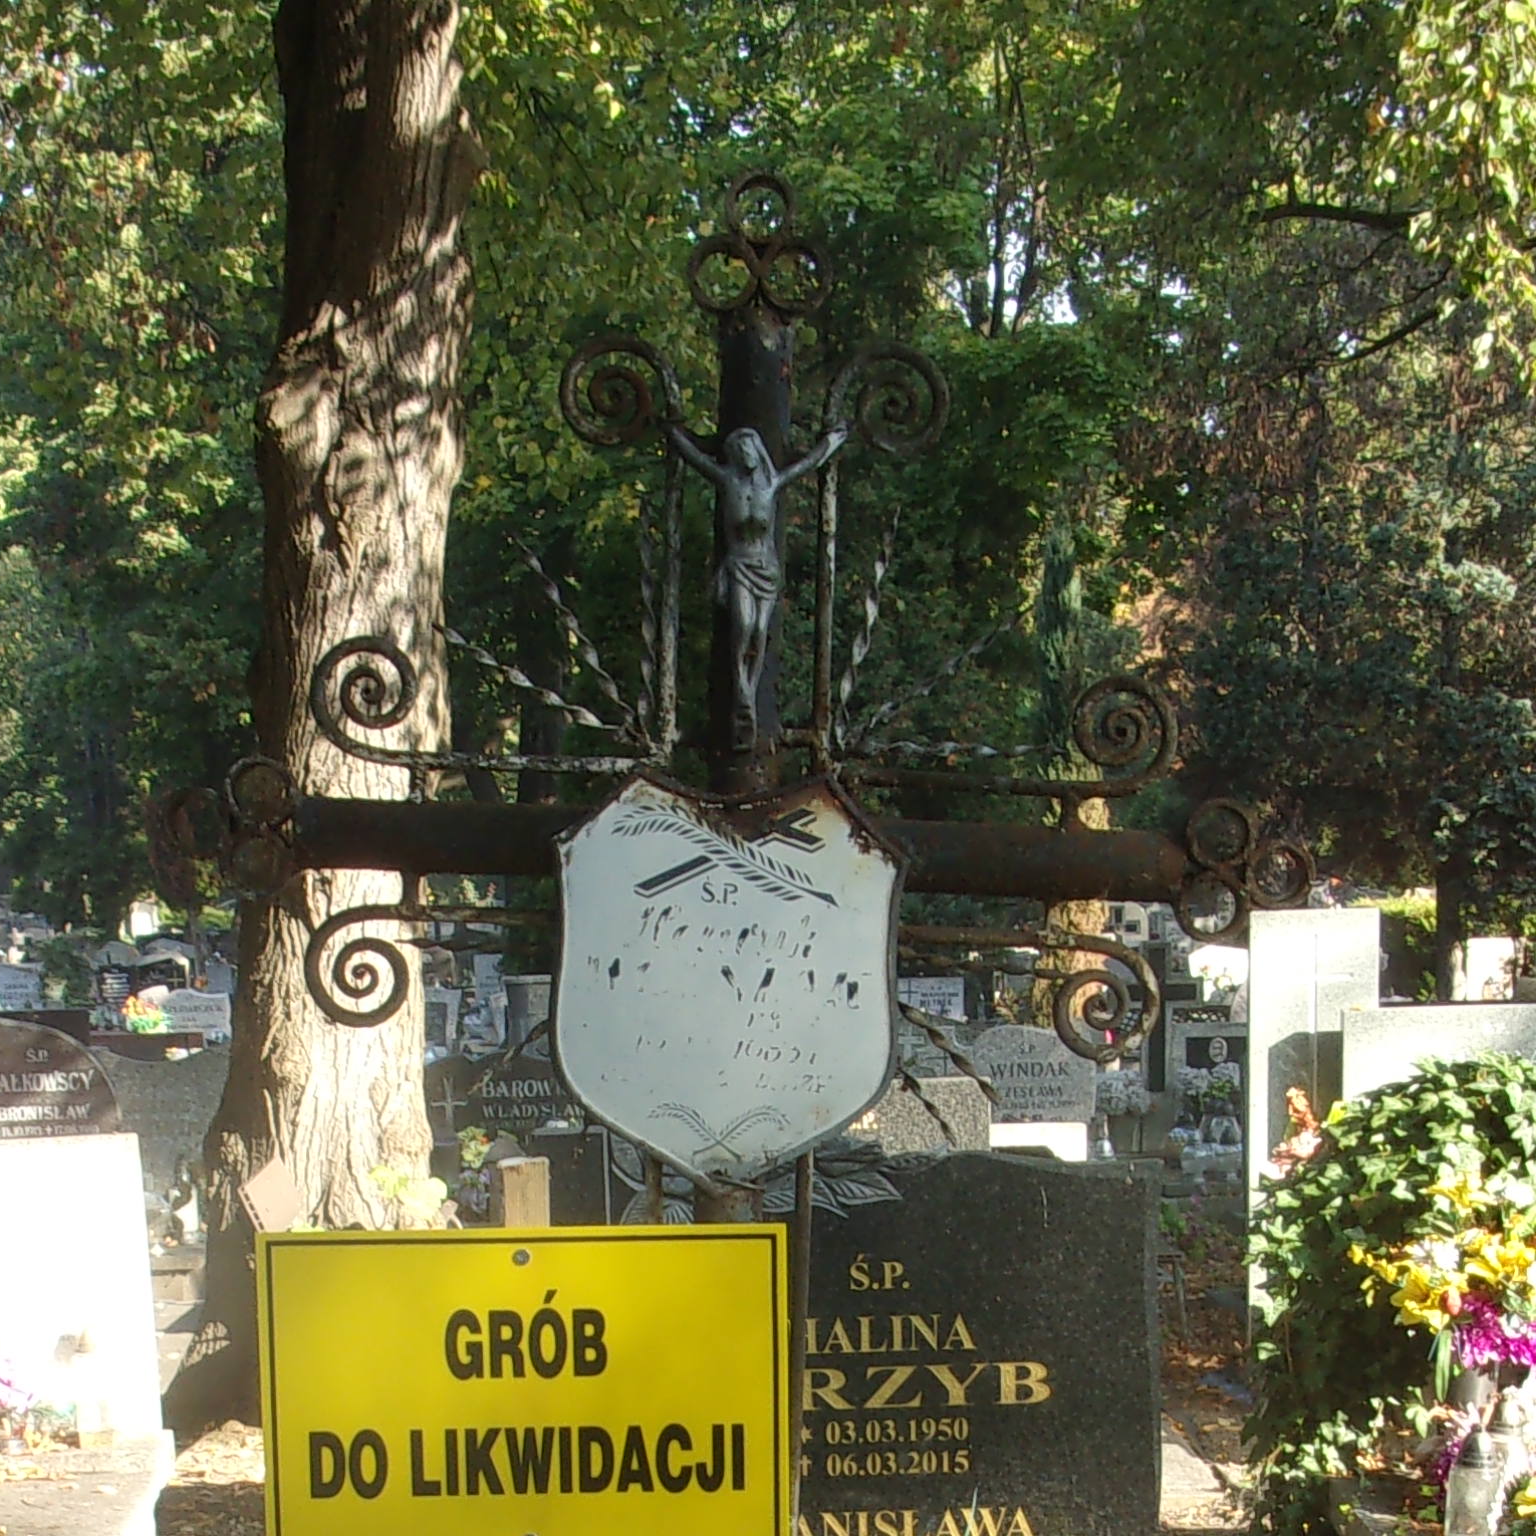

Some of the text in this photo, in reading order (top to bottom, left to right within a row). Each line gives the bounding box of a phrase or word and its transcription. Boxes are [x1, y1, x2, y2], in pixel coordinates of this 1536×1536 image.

[849, 1253, 912, 1291] Ś.P.
[445, 1289, 609, 1381] GRÓB
[802, 1360, 1053, 1412] RZYB
[825, 1416, 970, 1445] 03.03.1950
[309, 1423, 746, 1500] DO LIKWIDACJI
[826, 1449, 971, 1477] 06.03.2015
